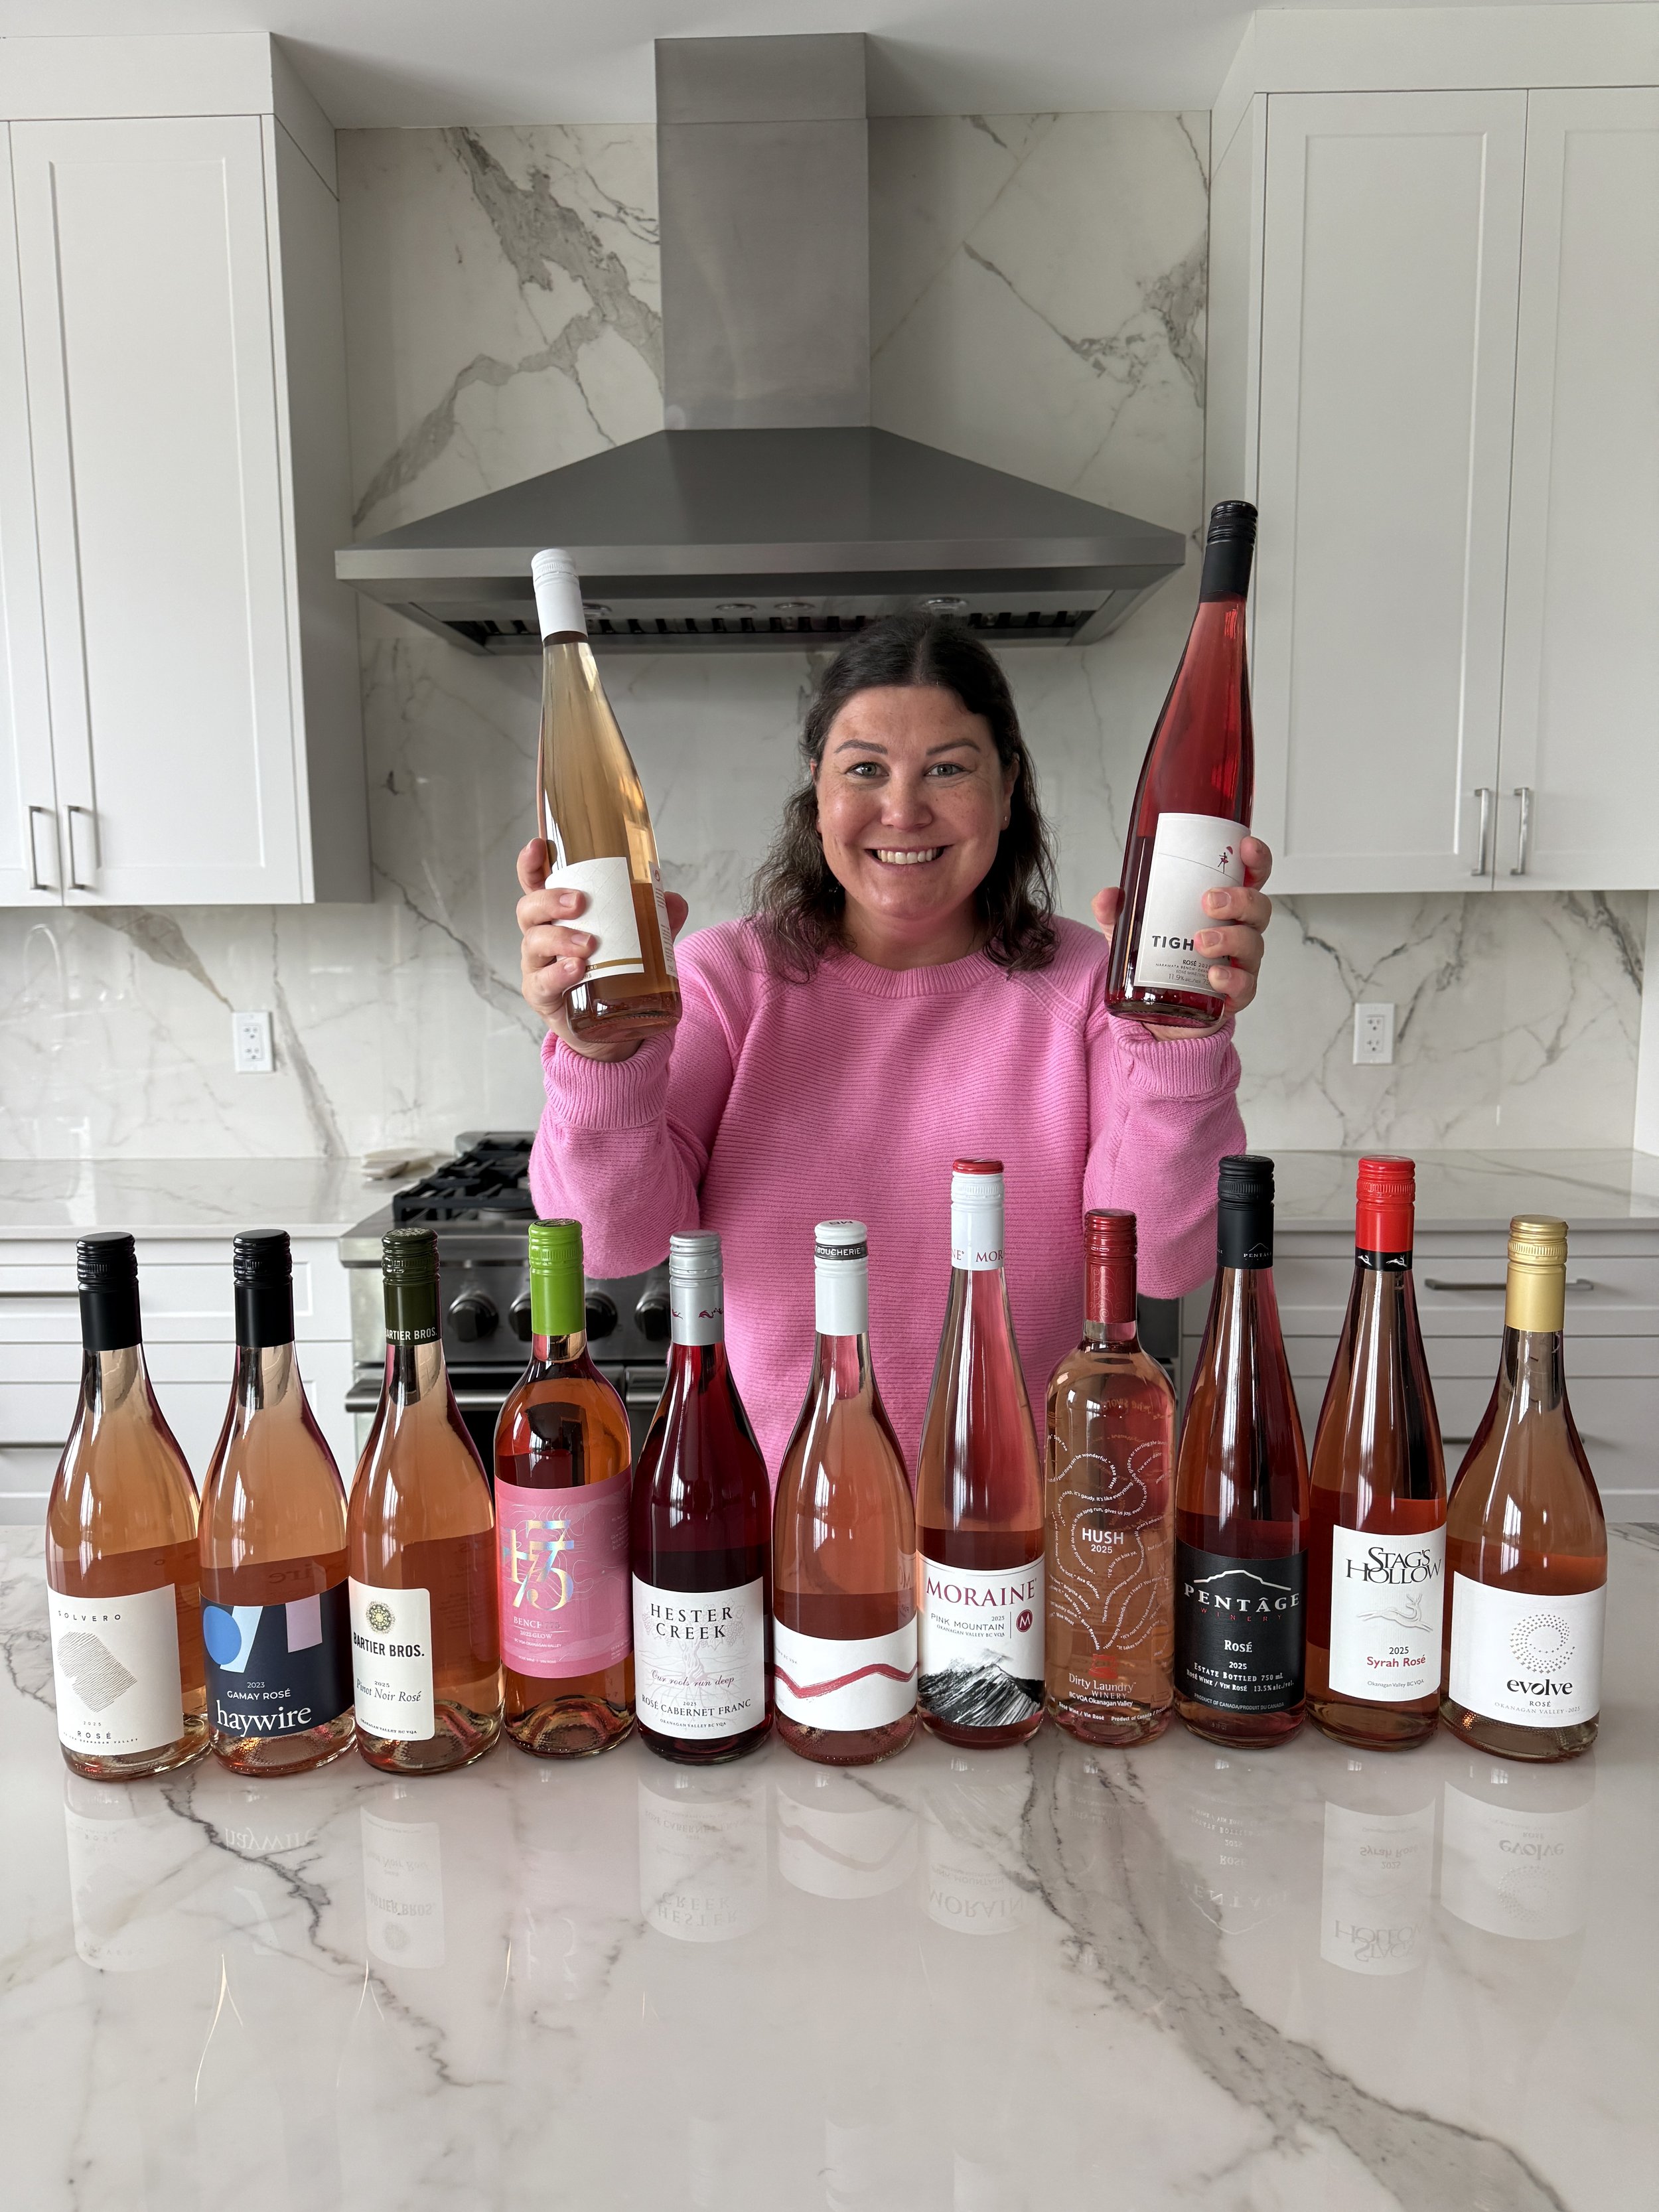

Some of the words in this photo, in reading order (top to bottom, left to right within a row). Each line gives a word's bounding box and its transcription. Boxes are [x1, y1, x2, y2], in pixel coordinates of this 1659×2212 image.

[1152, 935, 1194, 951] TIGH
[817, 1246, 861, 1256] BOUCHERIE
[976, 1250, 1004, 1262] MOR
[414, 1327, 437, 1340] BROS.
[1108, 1477, 1117, 1489] West
[1113, 1481, 1134, 1499] everything
[1074, 1552, 1086, 1568] should
[1135, 1441, 1150, 1452] sorting
[1082, 1528, 1123, 1544] HUSH
[1090, 1544, 1113, 1554] 2025
[1346, 1559, 1441, 1584] HOLLOW
[926, 1577, 1035, 1607] MORAINE
[1063, 1584, 1078, 1597] Brigitte
[1078, 1595, 1090, 1610] Bardot
[1086, 1580, 1100, 1599] Gardner
[1105, 1589, 1116, 1606] nothing
[1114, 1580, 1127, 1591] wrong
[1184, 1583, 1299, 1613] PENTÂGE
[58, 1611, 121, 1621] SOLVERO
[651, 1603, 733, 1623] HESTER
[1072, 1601, 1082, 1615] West
[1201, 1607, 1283, 1622] WINERY
[931, 1613, 950, 1625] PINK
[954, 1621, 1004, 1631] MOUNTAIN
[1064, 1615, 1074, 1626] West
[1116, 1606, 1126, 1628] husbands
[656, 1623, 727, 1640] CREEK
[937, 1624, 964, 1635] OKANAGAN
[1081, 1619, 1090, 1629] Burt
[1088, 1628, 1100, 1651] Reynolds
[1112, 1628, 1121, 1640] many
[353, 1632, 385, 1656] BARTIER
[389, 1645, 425, 1657] BROS.
[1229, 1661, 1247, 1670] 2025
[1367, 1657, 1399, 1668] Syrah
[1404, 1655, 1425, 1666] Rosé
[651, 1668, 666, 1682] Our
[669, 1676, 689, 1686] roots
[715, 1675, 735, 1688] deep
[1069, 1672, 1091, 1689] Dirty
[1094, 1680, 1133, 1692] Laundry
[227, 1690, 259, 1700] GAMAY
[263, 1688, 291, 1700] ROSÉ
[356, 1678, 372, 1696] Pinot
[374, 1688, 396, 1701] Noir
[398, 1691, 421, 1702] Rosé
[1092, 1690, 1127, 1699] WINERY
[1507, 1679, 1573, 1696] evolve
[642, 1694, 658, 1709] ROSÉ
[661, 1704, 715, 1716] CABERNET
[718, 1699, 751, 1714] FRANC
[1088, 1697, 1116, 1707] Okanagan
[1194, 1692, 1212, 1704] PRODUCT
[1058, 1702, 1068, 1710] Rosé
[1068, 1707, 1079, 1716] Wine
[1494, 1702, 1537, 1714] OKANAGAN
[216, 1700, 312, 1737] haywire
[660, 1718, 686, 1728] OKANAGAN
